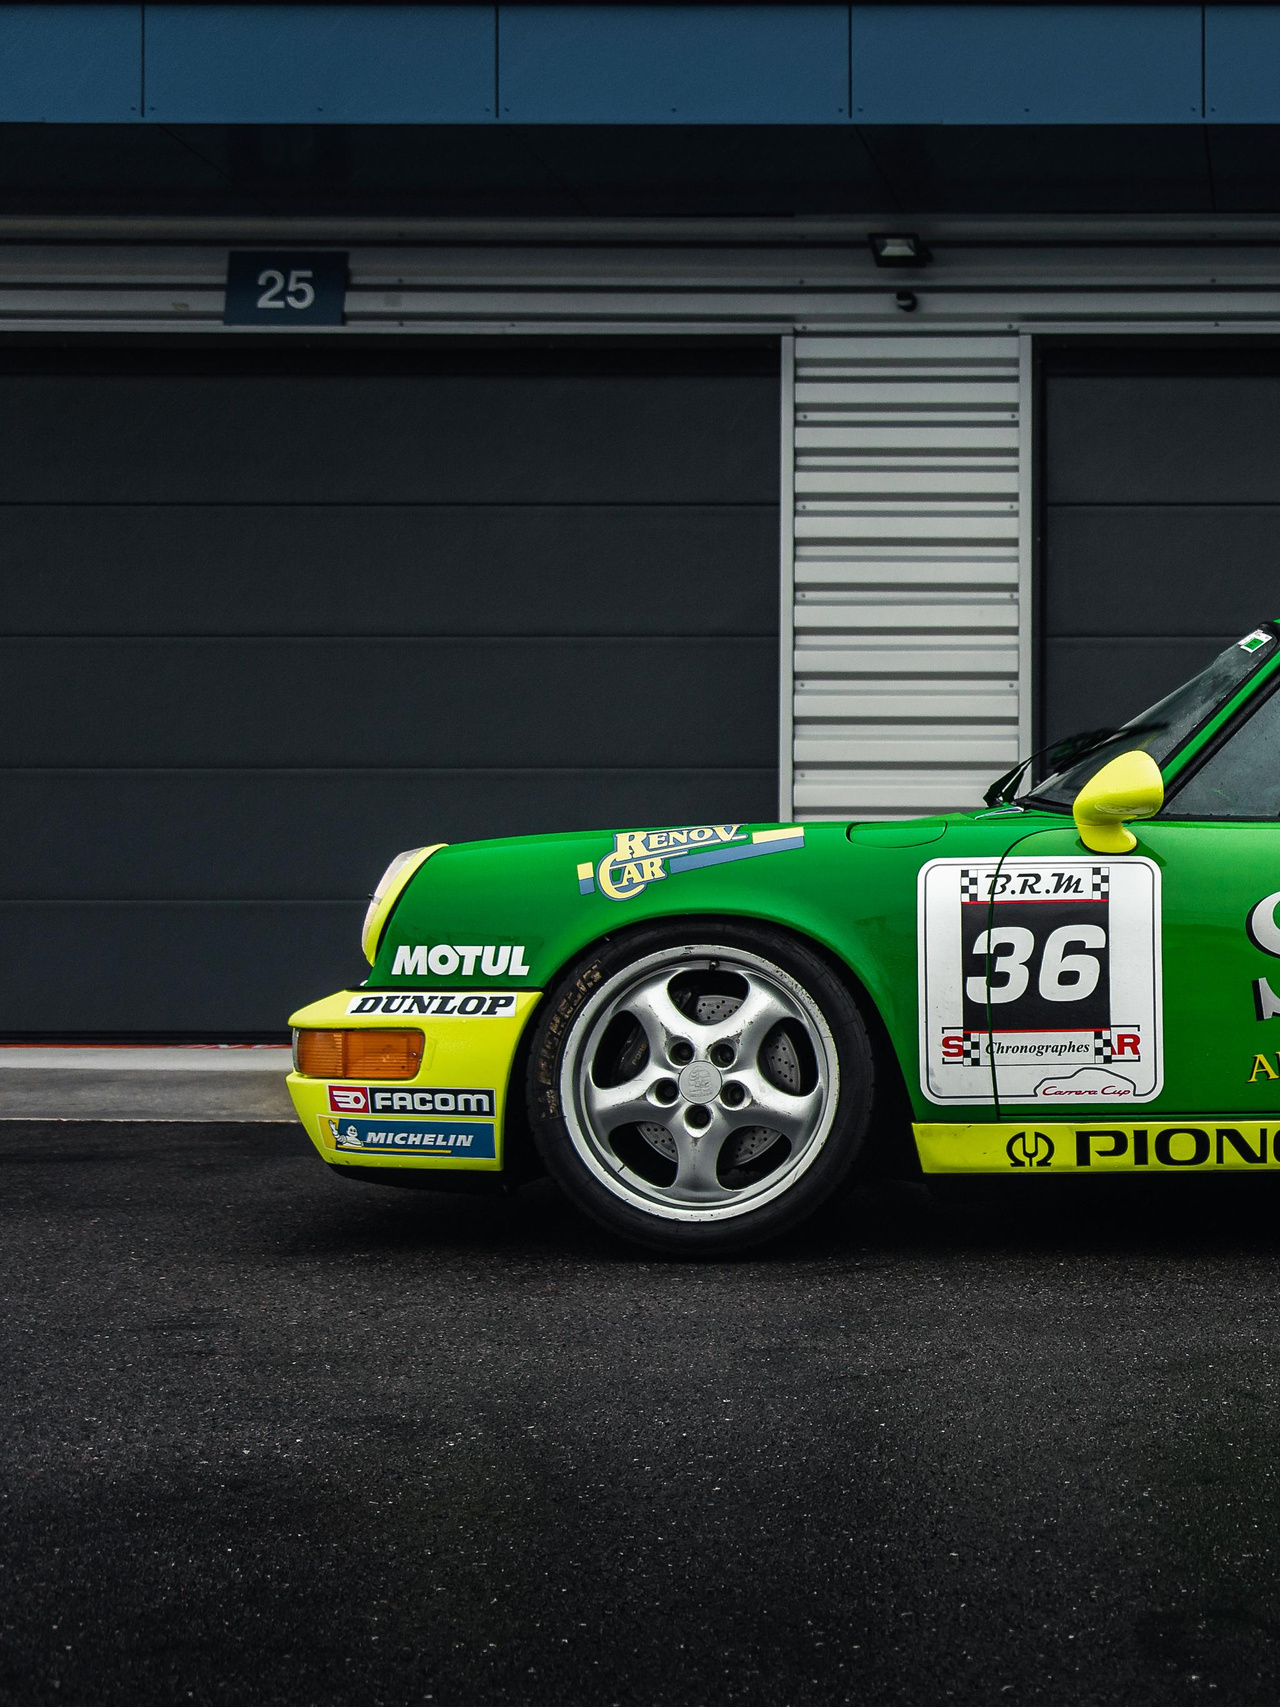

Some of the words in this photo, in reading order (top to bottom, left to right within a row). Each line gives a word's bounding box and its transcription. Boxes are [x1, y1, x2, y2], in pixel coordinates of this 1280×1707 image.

[256, 269, 315, 310] 25
[614, 825, 742, 862] RENOV
[599, 852, 666, 899] CAR
[391, 944, 530, 976] MOTUL
[966, 924, 1107, 1004] 36
[349, 995, 514, 1016] DUNLOP
[985, 1041, 1090, 1057] Chronographes
[374, 1091, 490, 1112] FACOM
[1042, 1085, 1098, 1096] Carrera
[1101, 1085, 1131, 1097] Cup
[366, 1132, 474, 1147] MICHELIN
